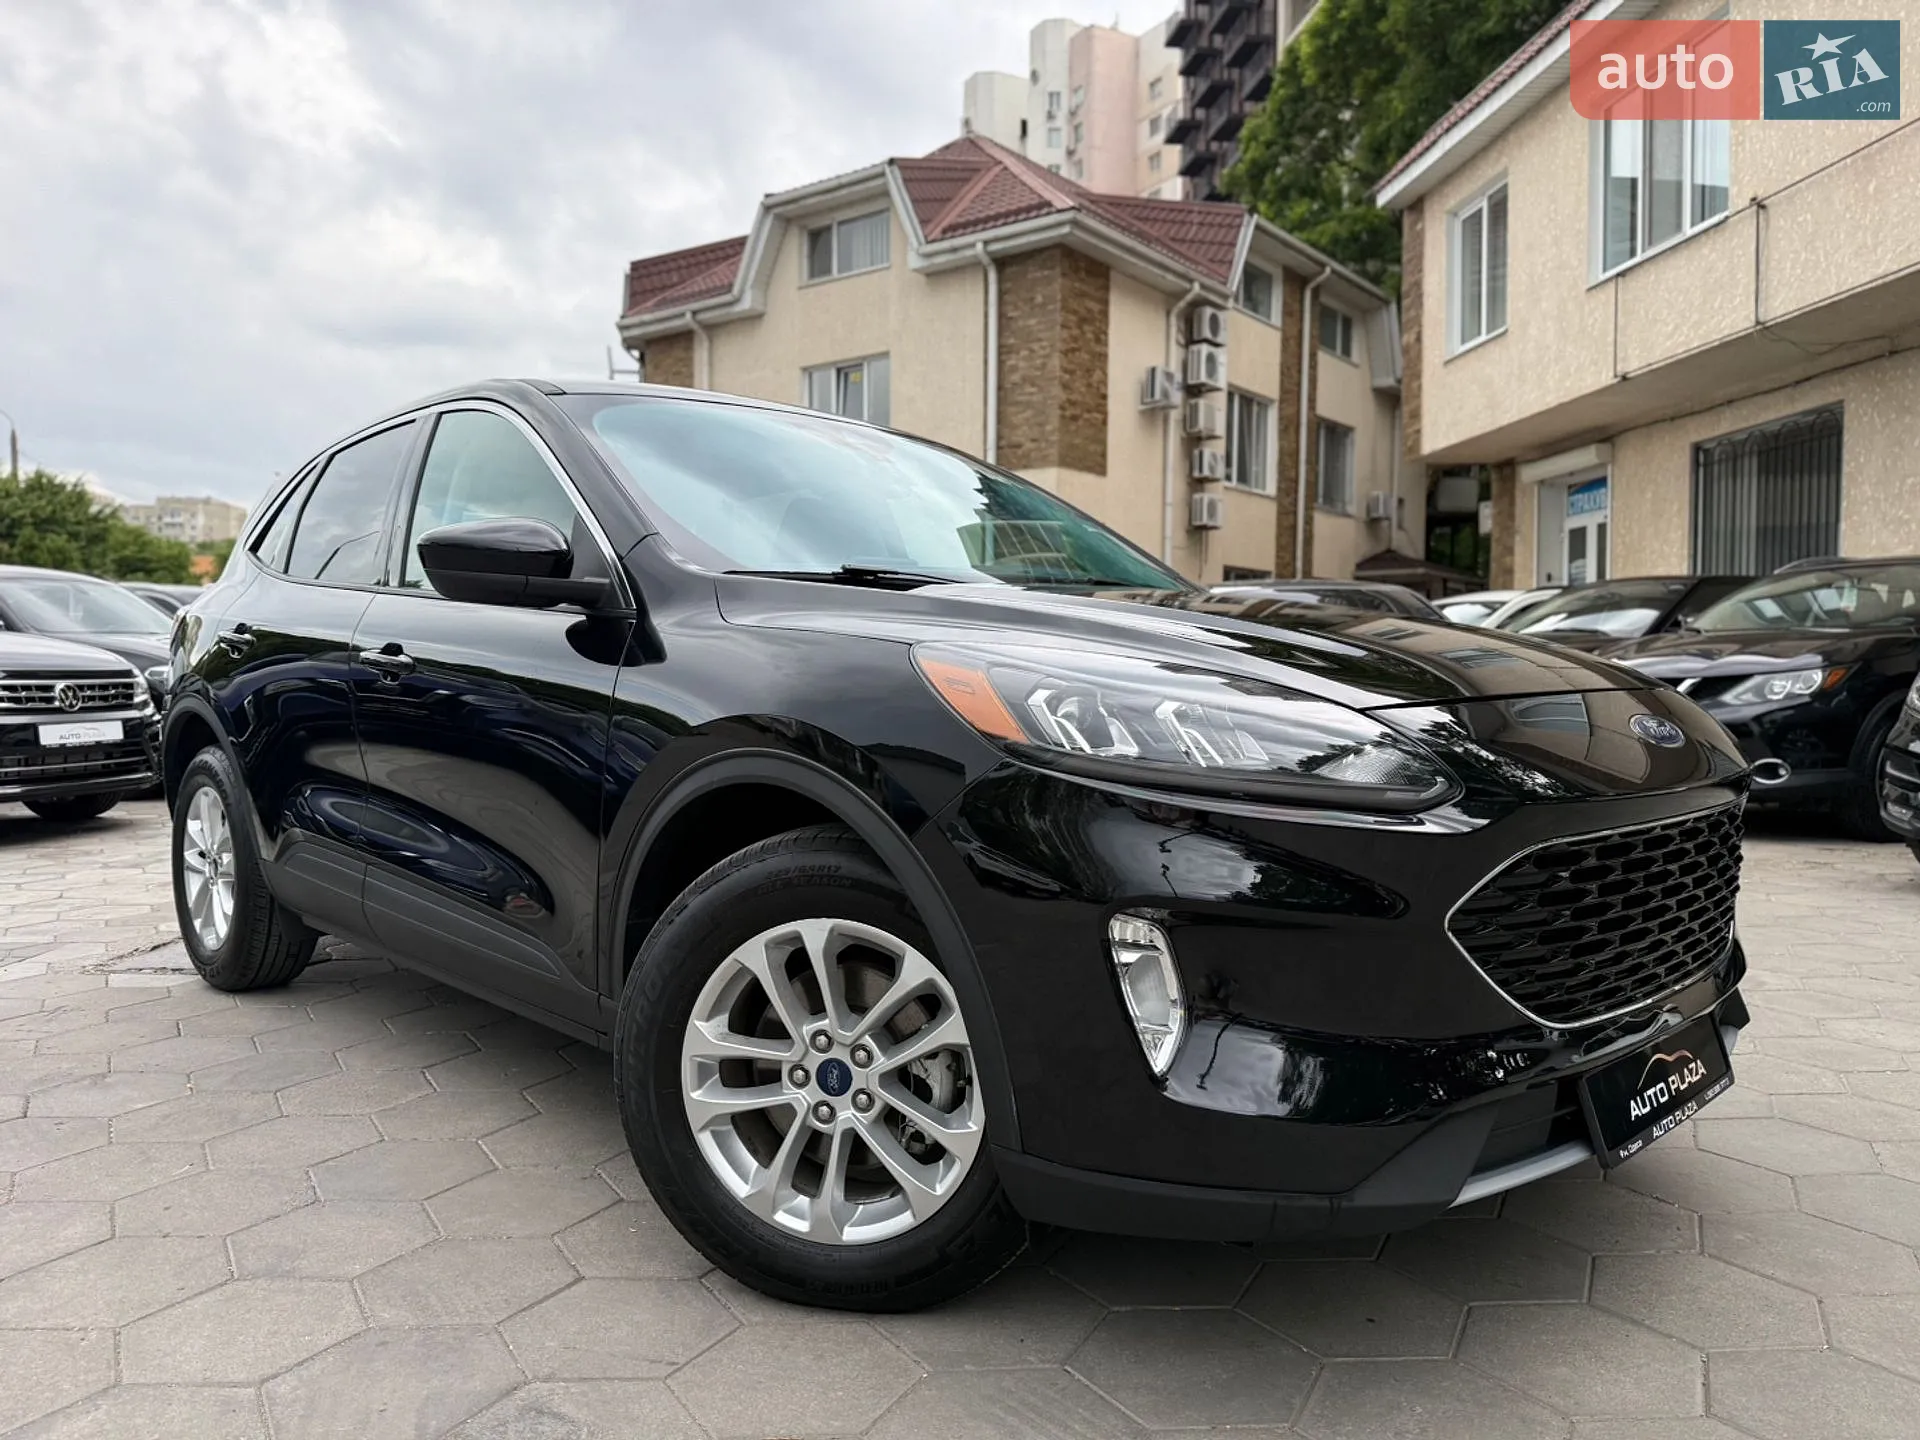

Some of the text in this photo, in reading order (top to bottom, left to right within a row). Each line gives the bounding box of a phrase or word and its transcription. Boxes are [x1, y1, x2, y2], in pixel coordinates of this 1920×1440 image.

[1630, 1082, 1669, 1121] AUTO
[1668, 1059, 1707, 1096] PLAZA
[1652, 1101, 1699, 1139] AUTO PLAZA
